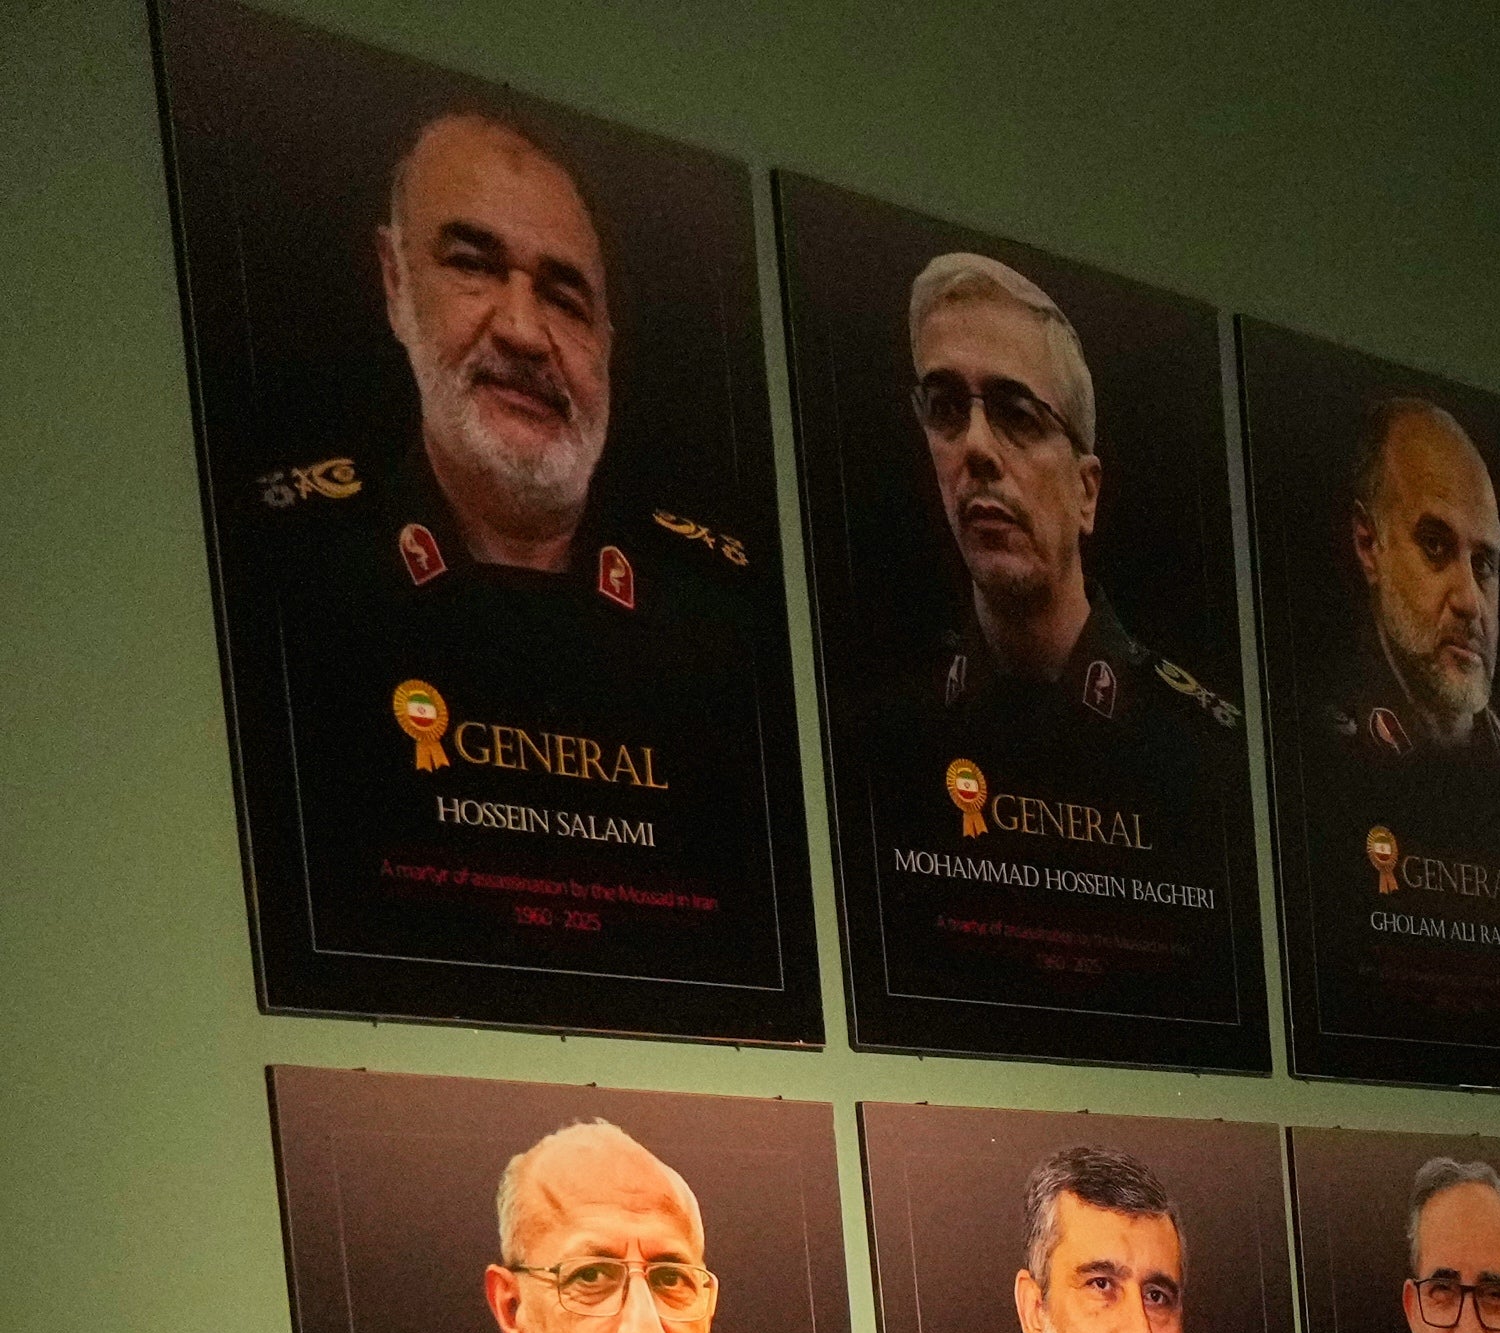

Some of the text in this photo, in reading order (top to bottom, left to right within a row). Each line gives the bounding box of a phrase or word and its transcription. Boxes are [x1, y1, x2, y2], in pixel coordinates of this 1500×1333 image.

[455, 722, 668, 789] GENERAL
[437, 796, 656, 847] HOSSEIN SALAMI
[992, 793, 1152, 850] GENERAL
[895, 849, 1214, 909] MOHAMMAD HOSSEIN BAGHERI
[1370, 911, 1445, 938] GHOLAM
[1451, 922, 1475, 942] ALI
